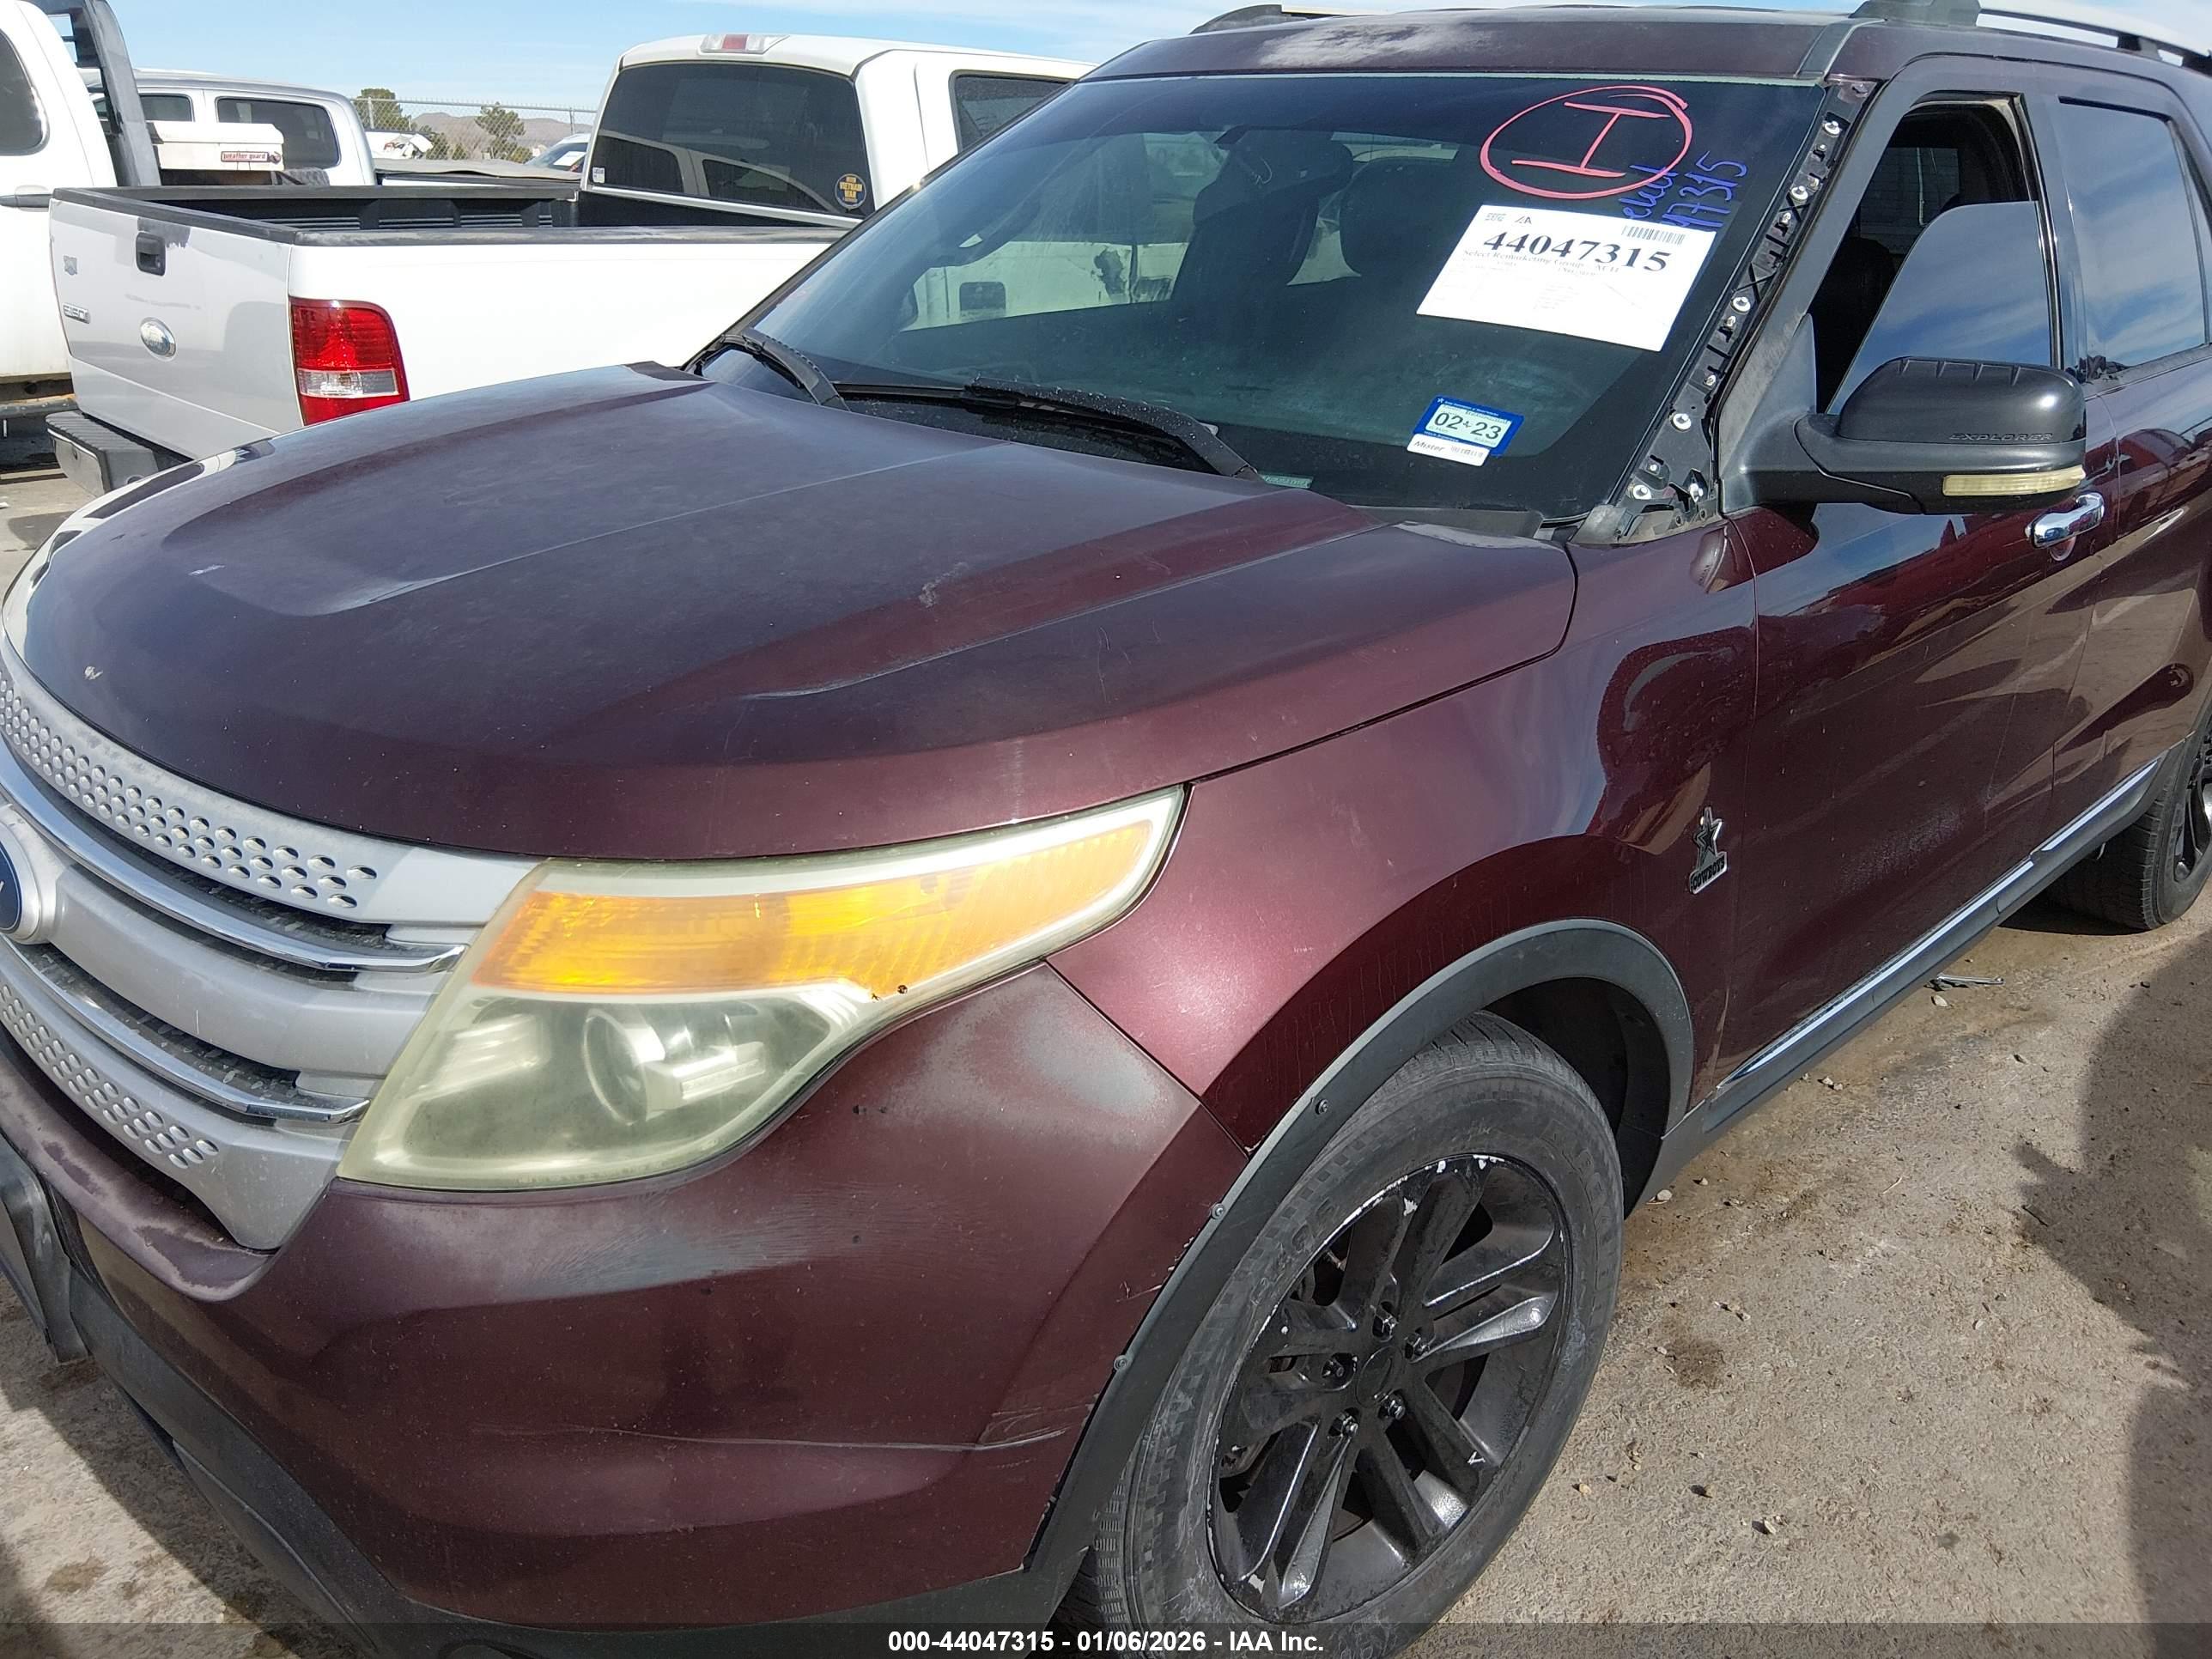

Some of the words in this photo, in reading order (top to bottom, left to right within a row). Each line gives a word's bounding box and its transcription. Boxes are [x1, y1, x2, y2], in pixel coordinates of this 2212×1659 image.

[1462, 250, 1491, 258] Select
[1492, 252, 1551, 265] Remarketing
[1484, 231, 1673, 272] 44047315
[1434, 413, 1464, 430] 02
[1470, 422, 1503, 440] 23
[1413, 441, 1446, 452] Mister
[1692, 856, 1724, 889] COWBOYS
